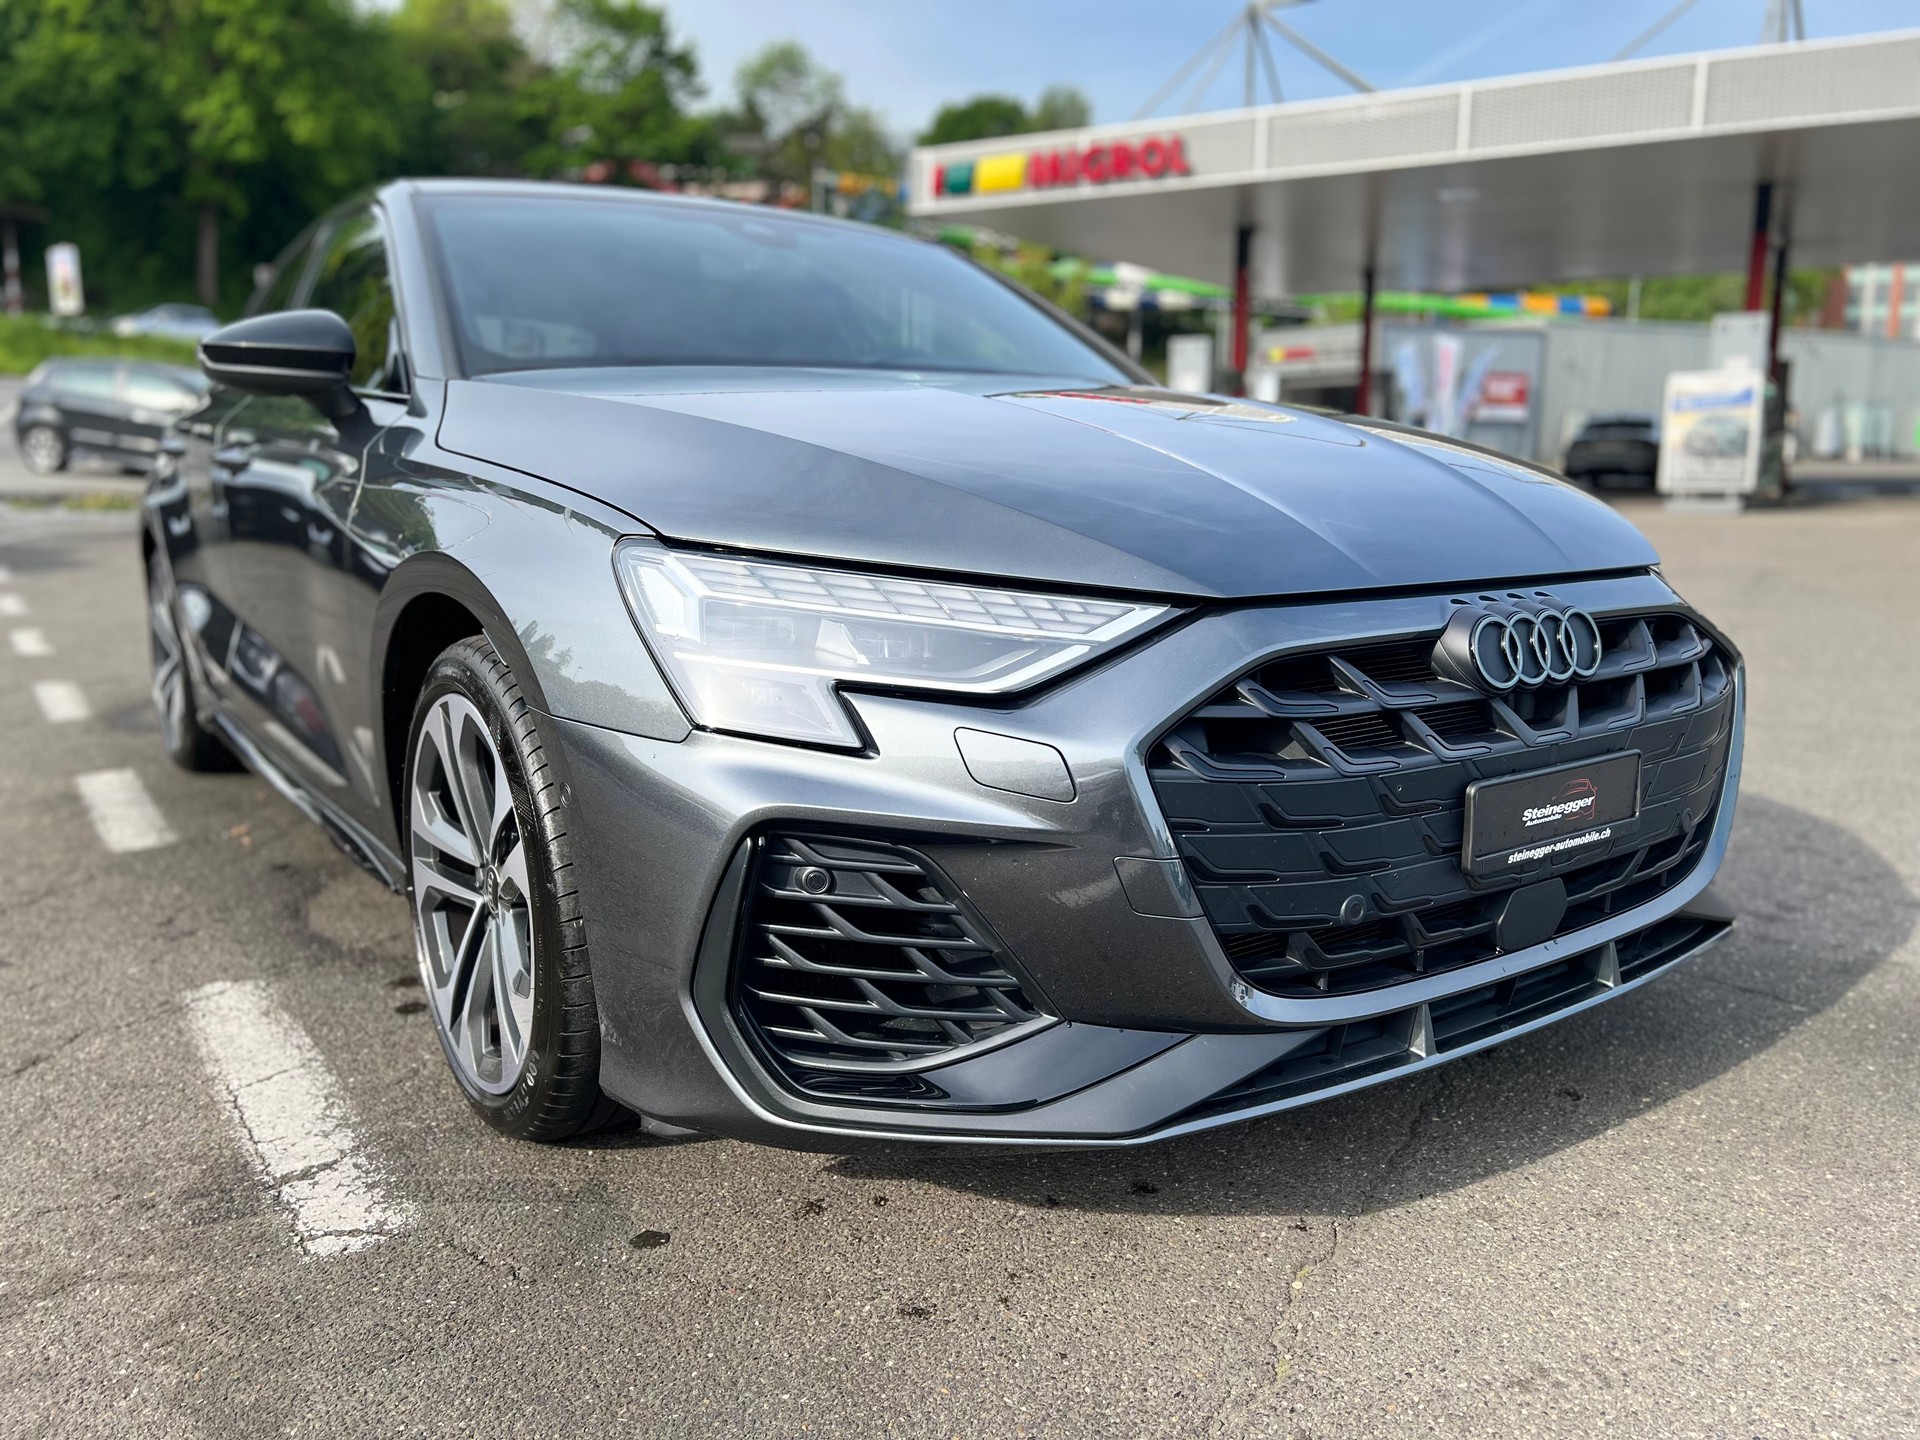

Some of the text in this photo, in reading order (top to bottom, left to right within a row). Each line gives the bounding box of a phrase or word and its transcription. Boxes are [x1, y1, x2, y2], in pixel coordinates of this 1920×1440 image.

[1030, 133, 1190, 188] MIGROL
[1522, 796, 1595, 821] Steinegger
[1525, 813, 1562, 827] Automobile
[1507, 827, 1611, 864] steinegger-automobile.ch
